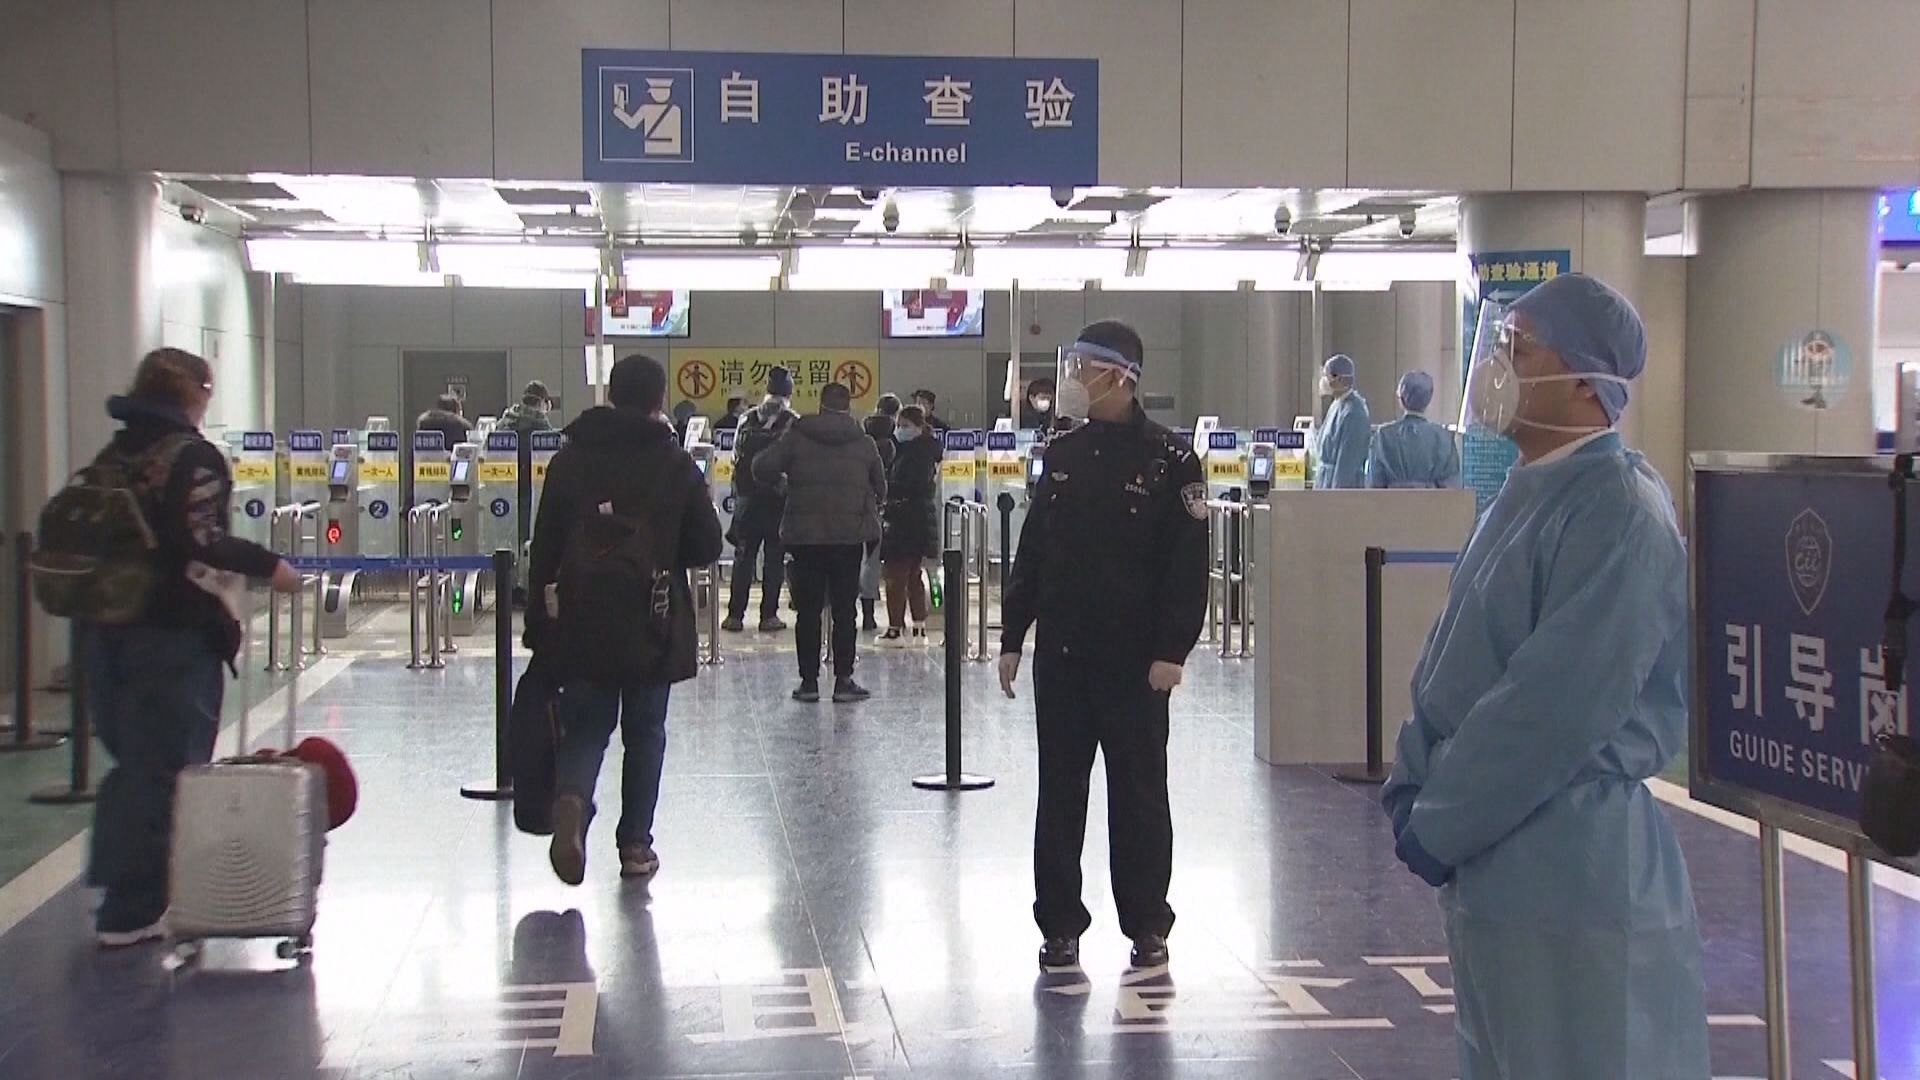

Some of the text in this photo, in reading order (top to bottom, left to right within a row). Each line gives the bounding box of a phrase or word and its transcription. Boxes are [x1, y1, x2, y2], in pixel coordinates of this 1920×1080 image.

[720, 70, 1075, 129] 自助查验
[845, 142, 967, 164] E-channel
[238, 465, 270, 476] 一次一人
[362, 466, 394, 477] 一次一人
[483, 466, 513, 476] 一次一人
[1729, 729, 1871, 793] GUIDE SERV
